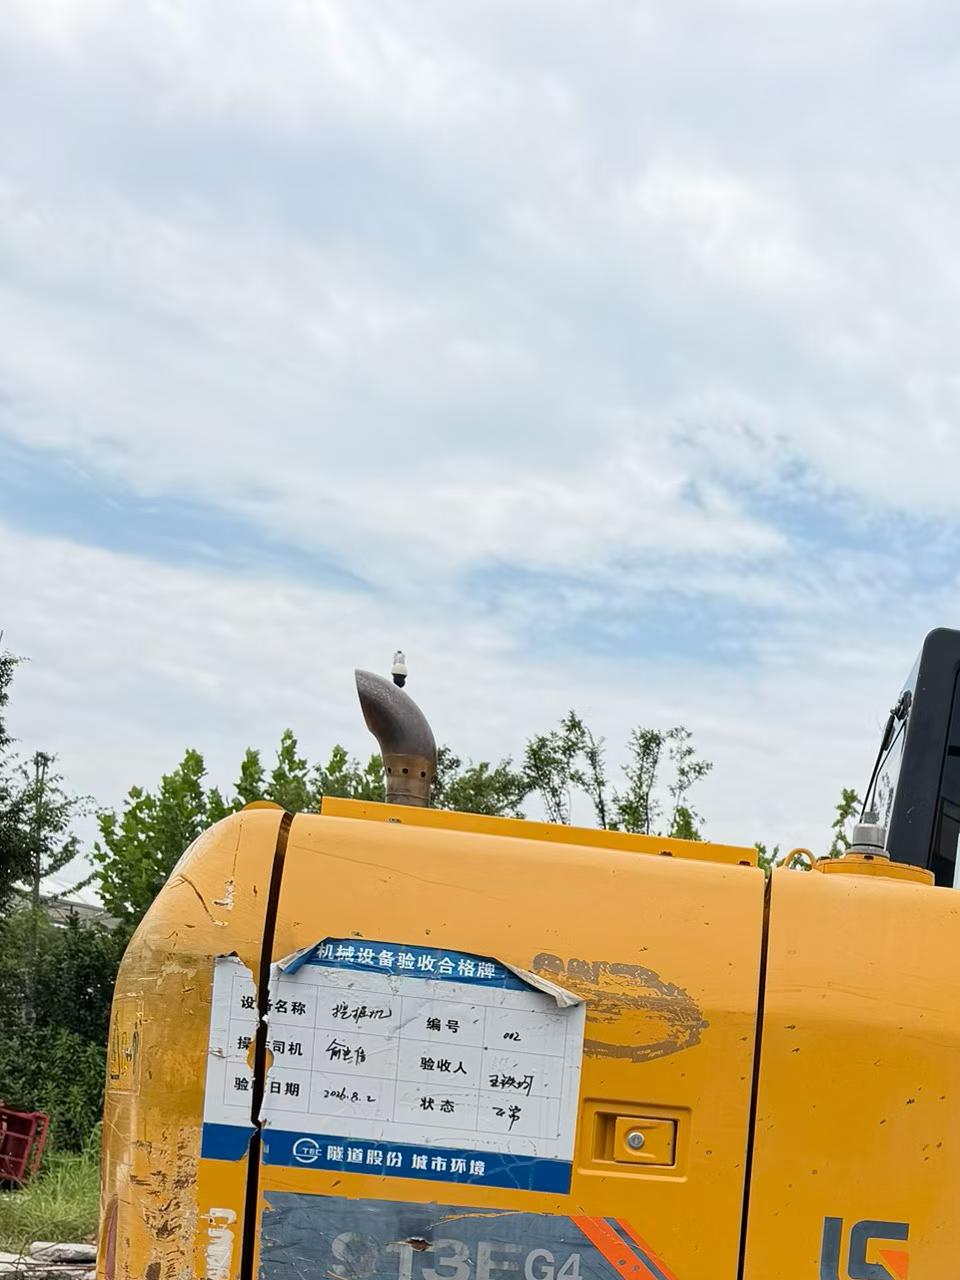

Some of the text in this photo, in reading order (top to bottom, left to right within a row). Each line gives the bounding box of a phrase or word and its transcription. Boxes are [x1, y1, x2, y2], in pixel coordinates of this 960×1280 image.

[316, 943, 496, 979] 机械设备验收合格牌
[425, 1017, 460, 1033] 编号
[237, 1036, 303, 1056] 操司机
[419, 1056, 467, 1074] 验收人
[233, 1077, 300, 1097] 验日期
[419, 1096, 454, 1113] 状态
[326, 1145, 486, 1176] 隧道股份 城市环境
